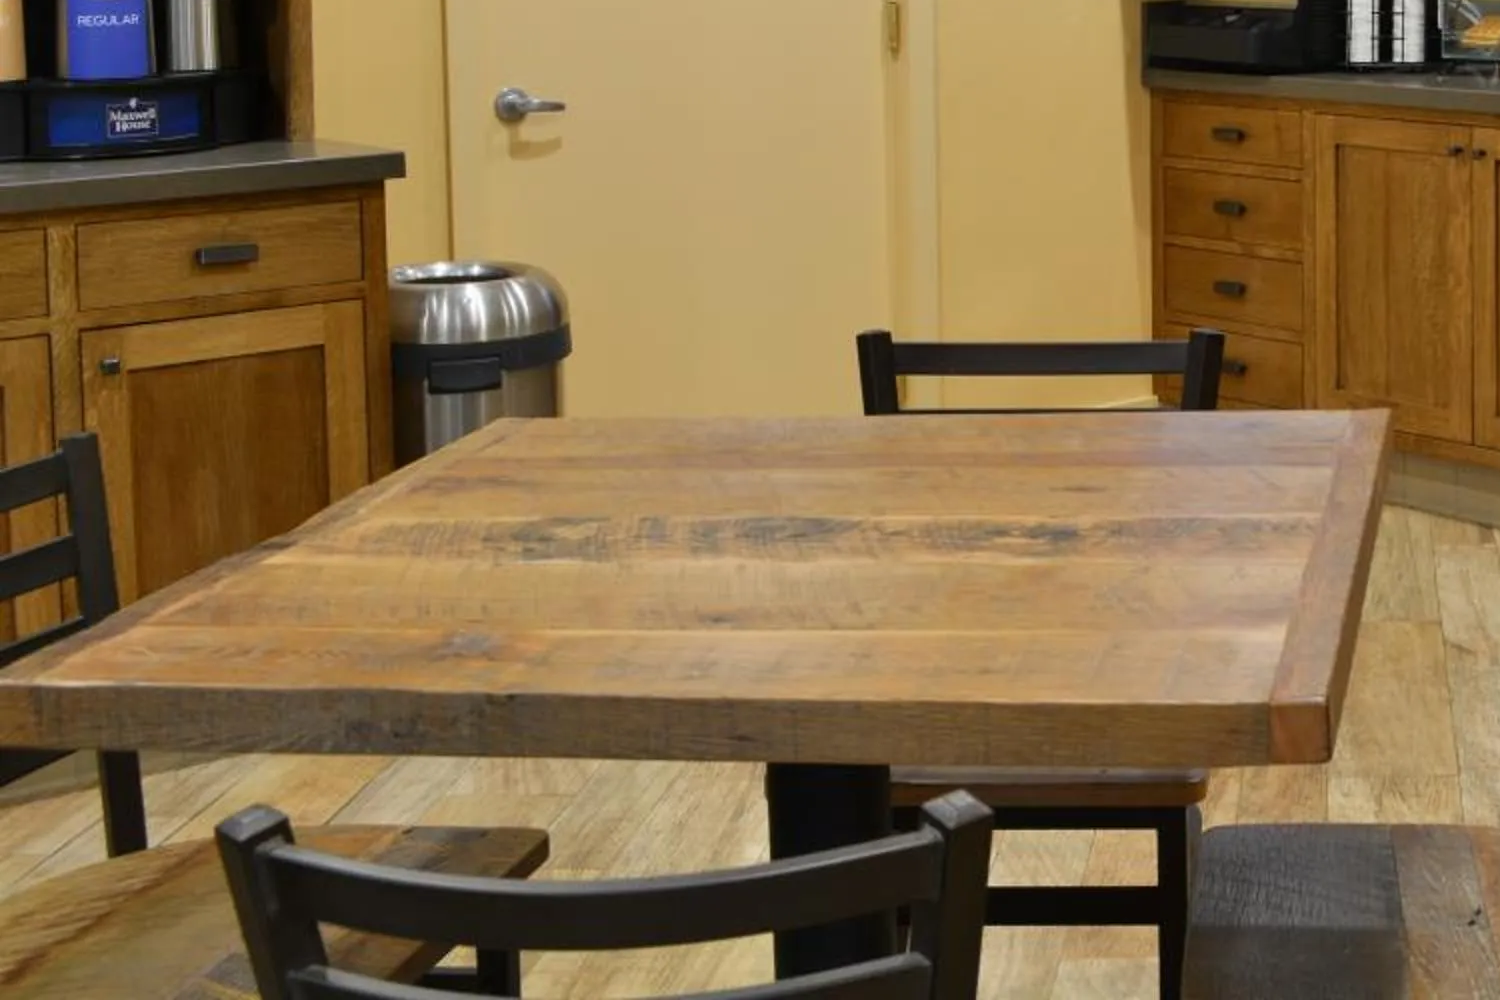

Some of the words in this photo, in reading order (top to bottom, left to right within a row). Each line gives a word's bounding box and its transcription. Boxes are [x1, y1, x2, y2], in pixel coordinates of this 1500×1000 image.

[77, 13, 139, 26] REGULAR
[109, 108, 156, 120] Maxwell
[114, 120, 152, 132] House
